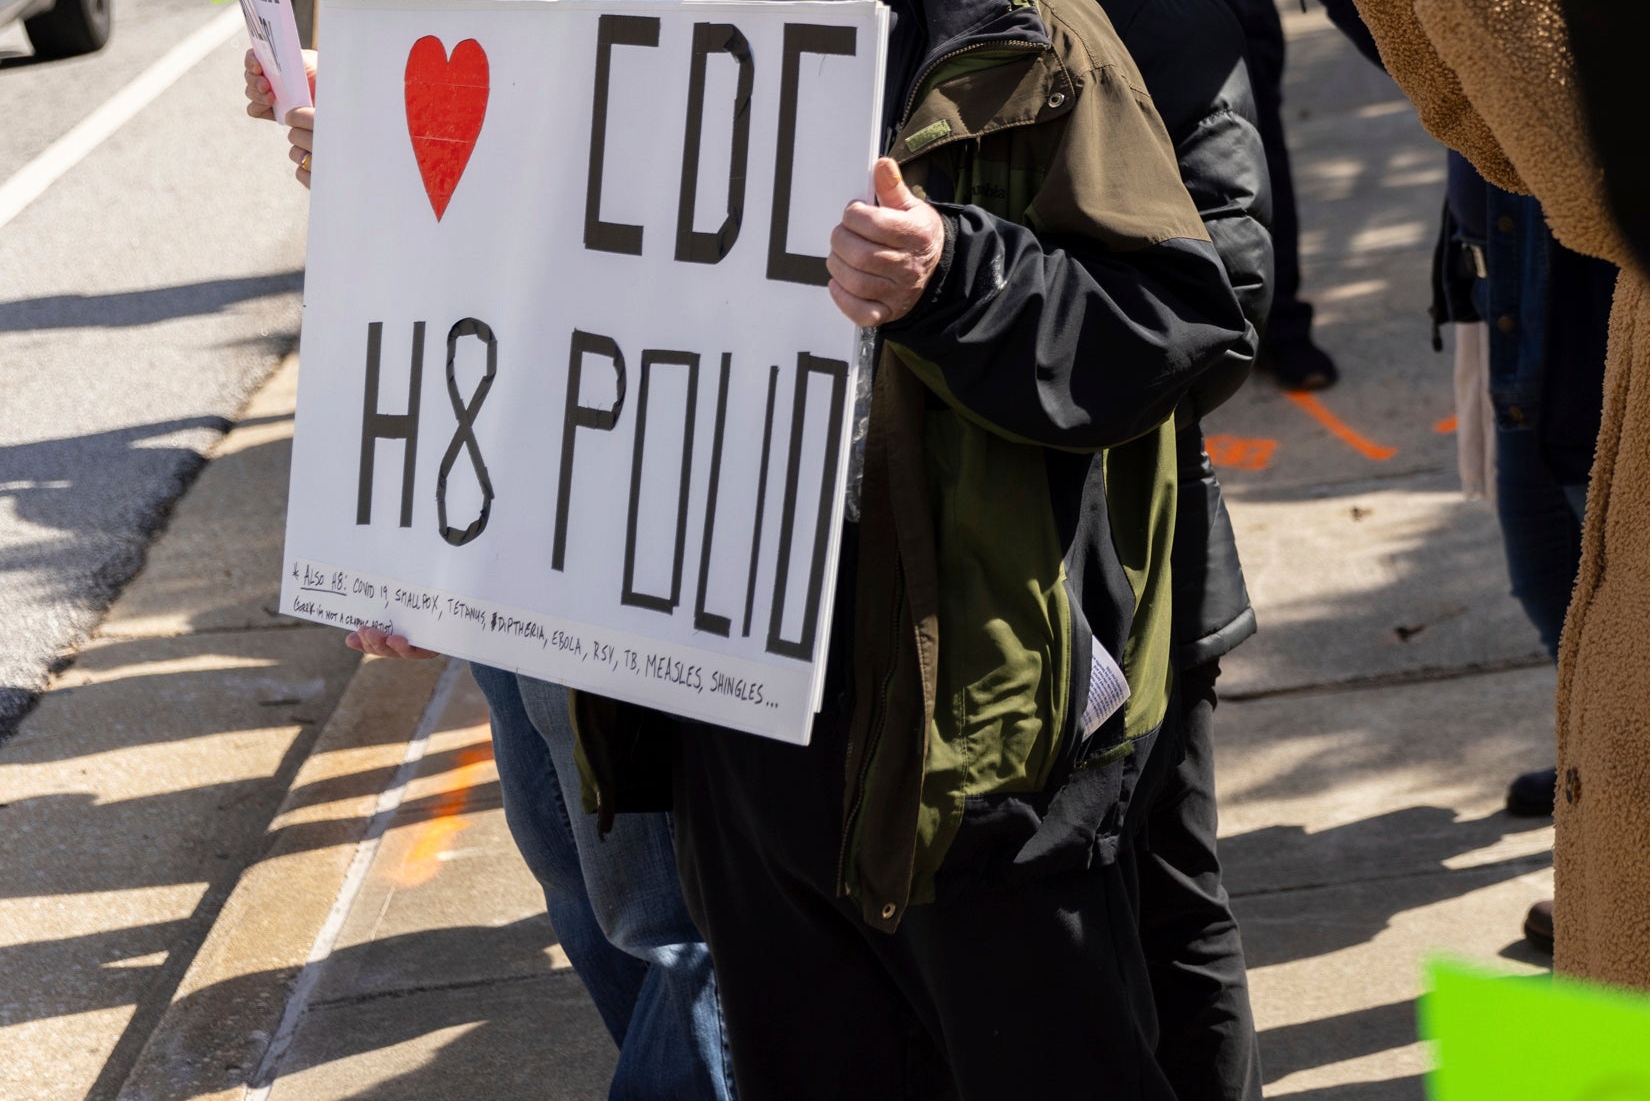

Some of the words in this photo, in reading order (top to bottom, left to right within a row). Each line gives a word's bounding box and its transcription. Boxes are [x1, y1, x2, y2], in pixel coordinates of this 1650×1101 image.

[584, 15, 857, 287] CDC
[356, 317, 498, 547] H8
[552, 327, 850, 662] POLIO
[304, 564, 325, 586] ALSO
[353, 578, 375, 599] COVID
[448, 598, 487, 630] TETANUS,
[551, 630, 588, 663] EBOLA,
[593, 640, 619, 672] RSV,
[624, 650, 641, 675] TB,
[645, 654, 704, 694] MEASLES,
